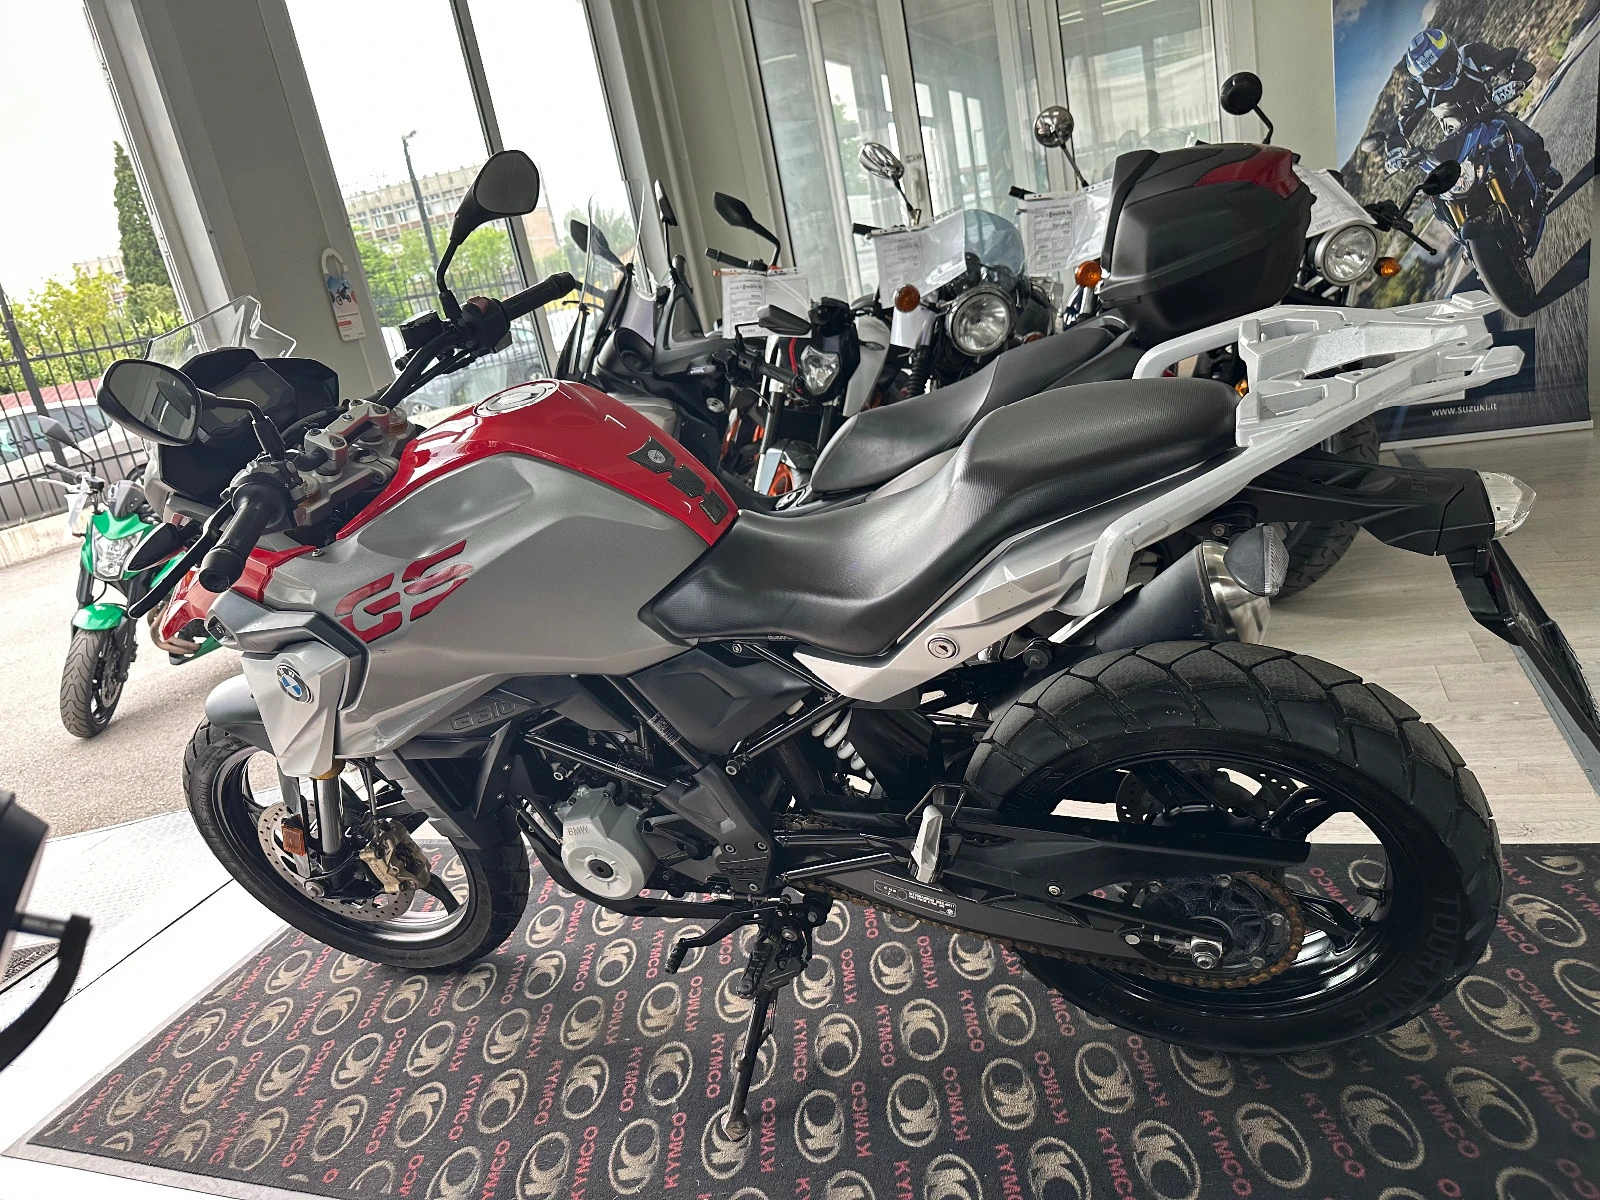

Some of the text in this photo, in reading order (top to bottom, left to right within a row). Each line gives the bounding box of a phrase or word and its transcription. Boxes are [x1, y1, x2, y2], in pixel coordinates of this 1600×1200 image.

[1431, 402, 1497, 417] www.suzuki.it
[334, 540, 474, 644] GS
[567, 825, 589, 836] BMW
[563, 899, 587, 945] KYMCO
[864, 906, 880, 939] MCO
[232, 956, 272, 1001] KYMCO
[297, 946, 334, 990] KYMCO
[500, 953, 528, 1005] KYMCO
[572, 943, 597, 992] KYMCO
[645, 929, 666, 979] KYMCO
[840, 948, 857, 1005] KYMCO
[916, 935, 939, 989] KYMCO
[217, 1001, 260, 1051] KYMCO
[286, 990, 327, 1041] KYMCO
[358, 979, 394, 1029] KYMCO
[525, 1003, 554, 1058] KYMCO
[603, 989, 629, 1046] KYMCO
[685, 975, 704, 1032] KYMCO
[958, 989, 985, 1052] KYMCO
[1505, 967, 1581, 1036] KYMCO
[370, 1027, 408, 1085] KYMCO
[448, 1015, 480, 1072] KYMCO
[705, 1032, 725, 1099] KYMCO
[793, 1018, 808, 1082] KYMCO
[875, 1004, 896, 1067] KYMCO
[143, 1062, 193, 1121] KYMCO
[217, 1051, 264, 1110] KYMCO
[294, 1039, 336, 1097] KYMCO
[533, 1060, 564, 1125] KYMCO
[619, 1047, 642, 1112] KYMCO
[1034, 1050, 1070, 1124] KYMCO
[1126, 1034, 1171, 1107] KYMCO
[1512, 1055, 1596, 1139] KYMCO
[69, 1073, 124, 1134] KYMCO
[280, 1098, 328, 1168] KYMCO
[364, 1086, 406, 1154] KYMCO
[447, 1073, 483, 1141] KYMCO
[851, 1081, 873, 1158] KYMCO
[943, 1066, 971, 1141] KYMCO
[1405, 1074, 1480, 1159] KYMCO
[663, 1111, 687, 1190] KYMCO
[760, 1097, 777, 1173] KYMCO
[1096, 1127, 1138, 1200] KYMC
[1198, 1109, 1252, 1196] KYMCO
[1302, 1091, 1366, 1179] KYMCO
[481, 1139, 511, 1200] YMCO
